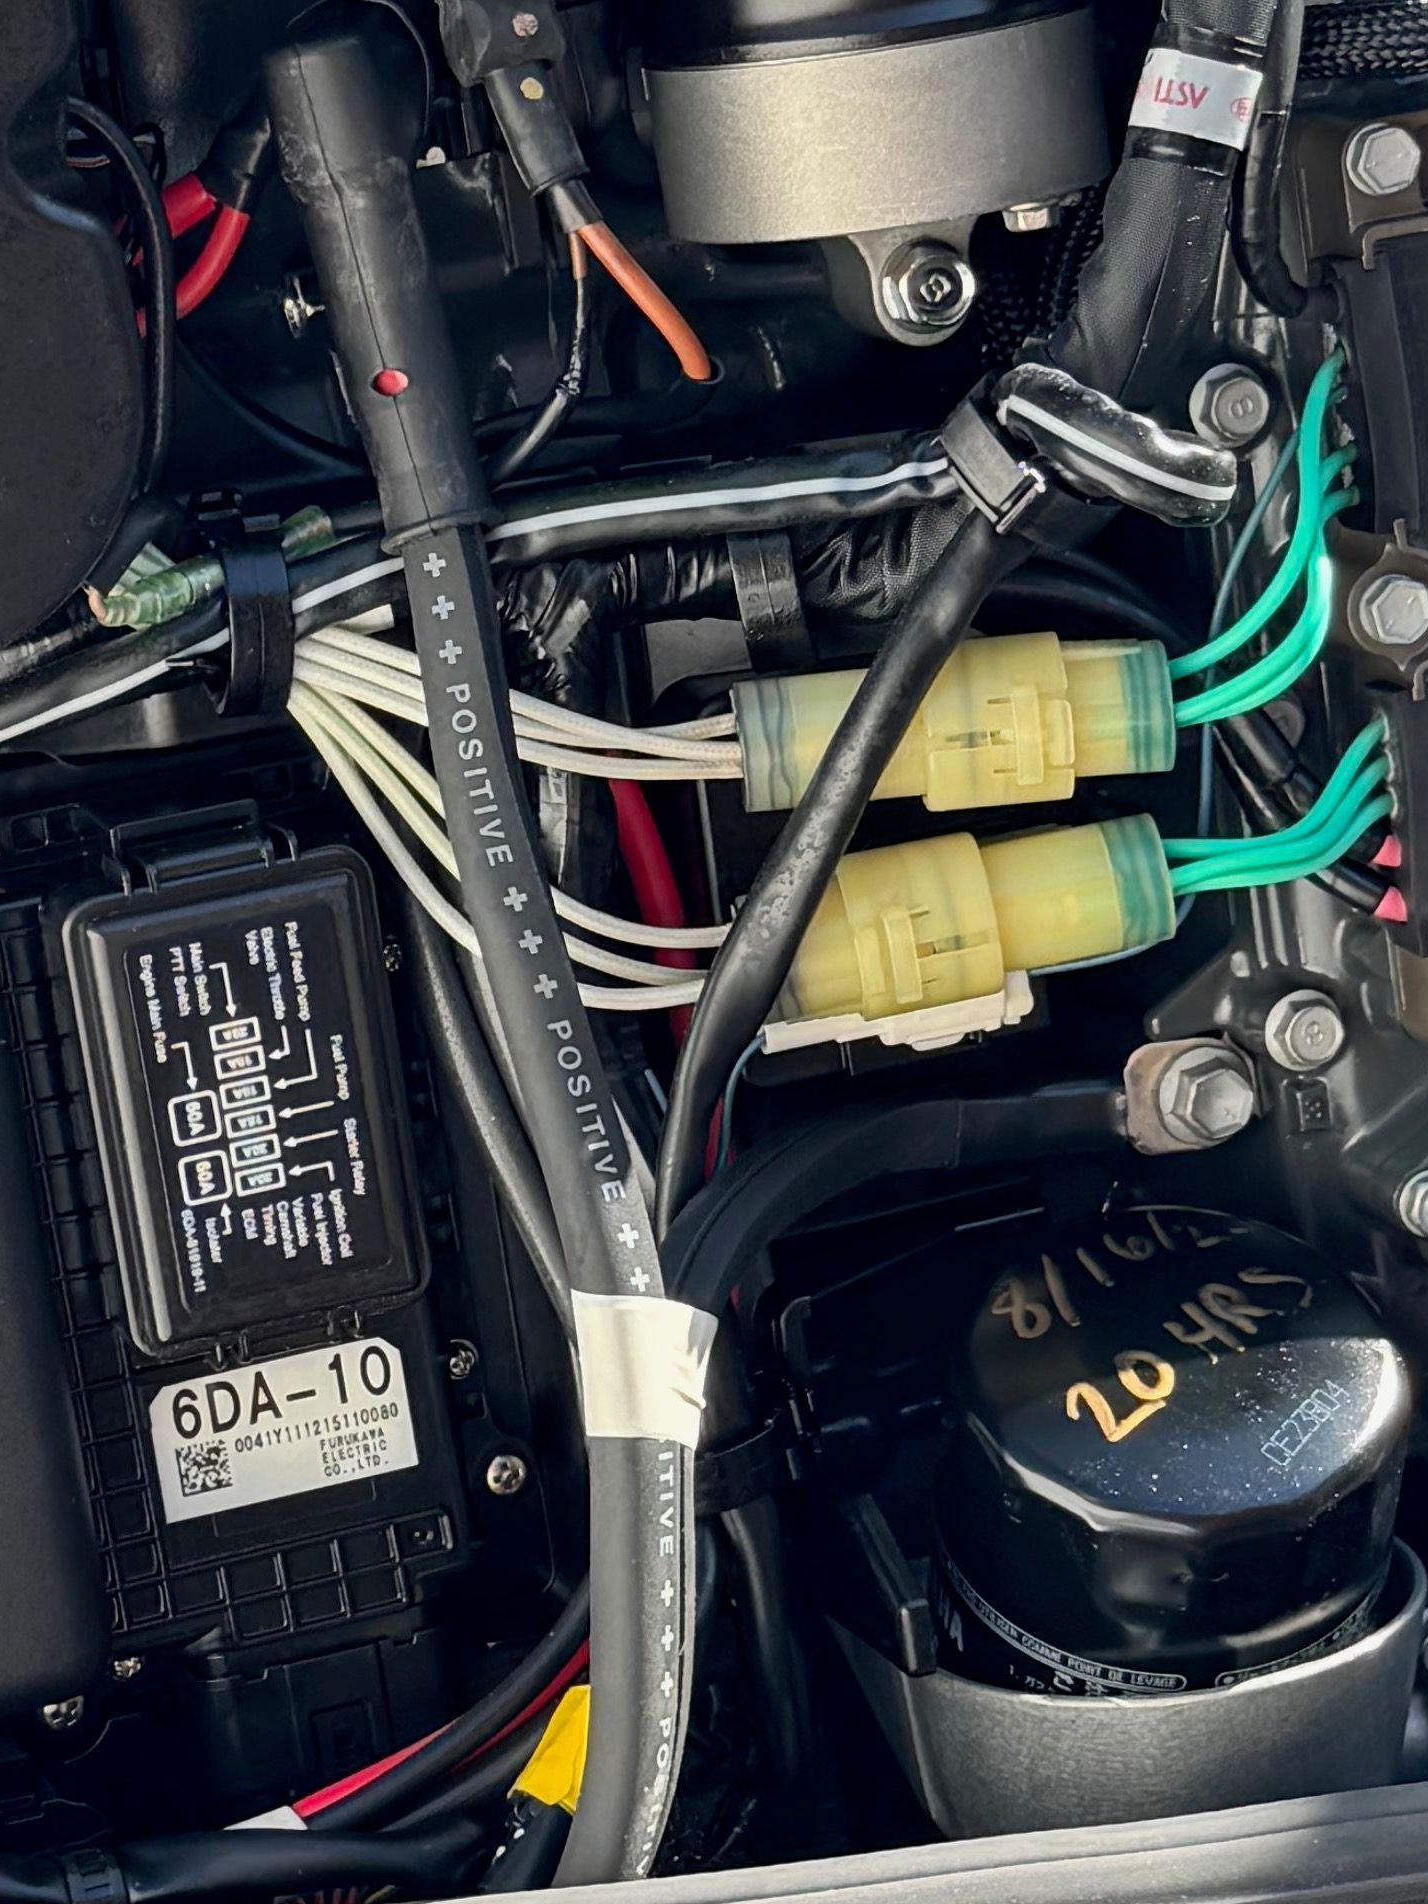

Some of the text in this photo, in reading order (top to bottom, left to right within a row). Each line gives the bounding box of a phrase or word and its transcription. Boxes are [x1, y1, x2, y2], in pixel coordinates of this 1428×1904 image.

[446, 683, 514, 867] POSITIVE
[169, 946, 191, 1017] PTT Switch
[189, 942, 212, 1016] Main Switch
[245, 929, 260, 965] Valve
[260, 926, 286, 1020] Electric Throttle
[285, 921, 311, 1022] Fuel Feed Pump
[139, 954, 167, 1063] Engine Main Fuse
[330, 1034, 350, 1100] Fuel Pump
[185, 1101, 205, 1136] 60A
[547, 1019, 626, 1203] POSITIVE
[196, 1161, 215, 1195] 60A
[343, 1118, 366, 1195] Starter Relay
[241, 1208, 258, 1240] ECM
[261, 1204, 277, 1246] Timing
[276, 1200, 296, 1259] Camshaft
[292, 1196, 310, 1247] Variable
[311, 1192, 333, 1265] Fuel Injector
[328, 1188, 353, 1258] Ignition Coil
[172, 1345, 391, 1439] 6DA-10
[1065, 1349, 1175, 1443] 20
[234, 1402, 399, 1453] 0041Y111215110080
[320, 1427, 385, 1451] FURUKAWA
[322, 1439, 387, 1464] ELECTRIC
[655, 1437, 676, 1558] ITIVE
